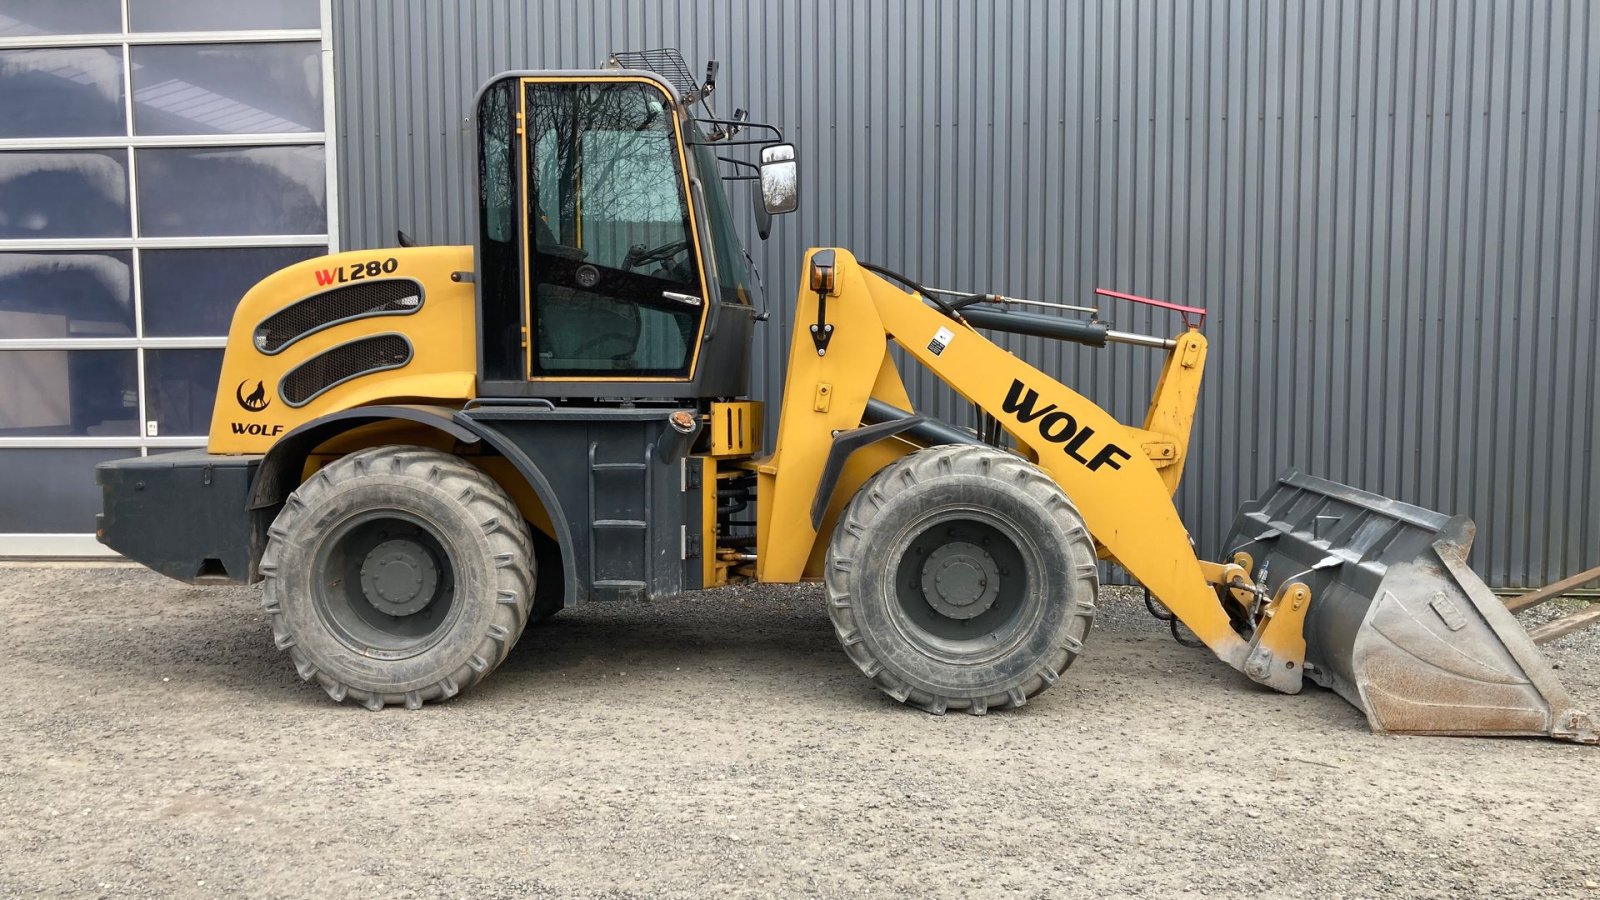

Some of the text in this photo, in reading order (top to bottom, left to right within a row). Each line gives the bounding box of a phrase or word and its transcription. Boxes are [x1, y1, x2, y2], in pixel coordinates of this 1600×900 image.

[315, 258, 398, 286] WL280
[232, 423, 284, 436] WOLF
[1002, 378, 1132, 472] WOLF
